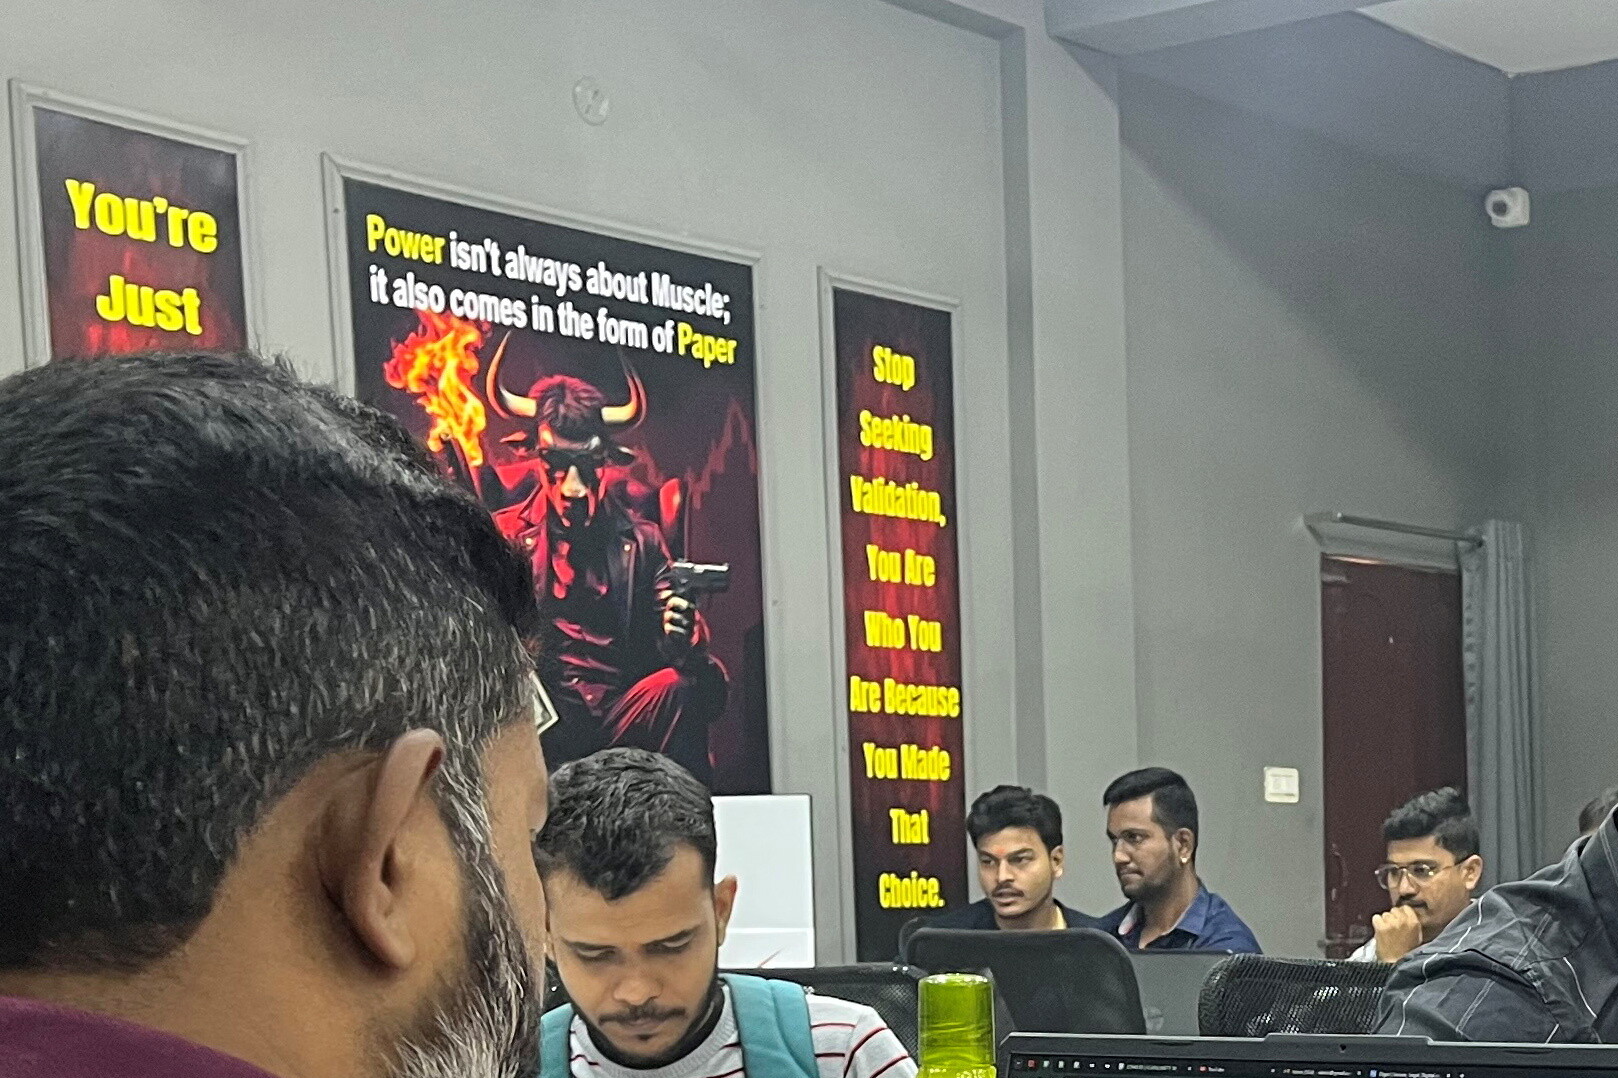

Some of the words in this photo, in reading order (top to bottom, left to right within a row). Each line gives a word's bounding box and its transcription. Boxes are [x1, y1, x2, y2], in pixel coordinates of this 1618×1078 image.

[65, 178, 218, 254] You're
[366, 214, 446, 264] Power
[449, 231, 502, 276] isn't
[504, 244, 583, 297] always
[585, 260, 649, 305] about
[651, 271, 731, 325] Muscle;
[95, 274, 203, 336] Just
[369, 264, 389, 304] it
[392, 271, 446, 314] also
[450, 288, 528, 329] comes
[531, 294, 554, 333] in
[557, 301, 594, 340] the
[596, 307, 649, 349] form
[652, 319, 675, 354] of
[677, 321, 737, 369] Paper
[872, 345, 916, 391] Stop
[859, 409, 934, 461] Seeking
[850, 474, 947, 528] Validation,
[866, 544, 902, 583] You
[904, 548, 937, 587] Are
[864, 610, 905, 649] Who
[907, 614, 943, 652] You
[850, 675, 882, 713] Are
[883, 677, 961, 718] Because
[862, 742, 898, 779] You
[900, 743, 951, 781] Made
[889, 807, 930, 844] That
[879, 870, 945, 909] Choice.
